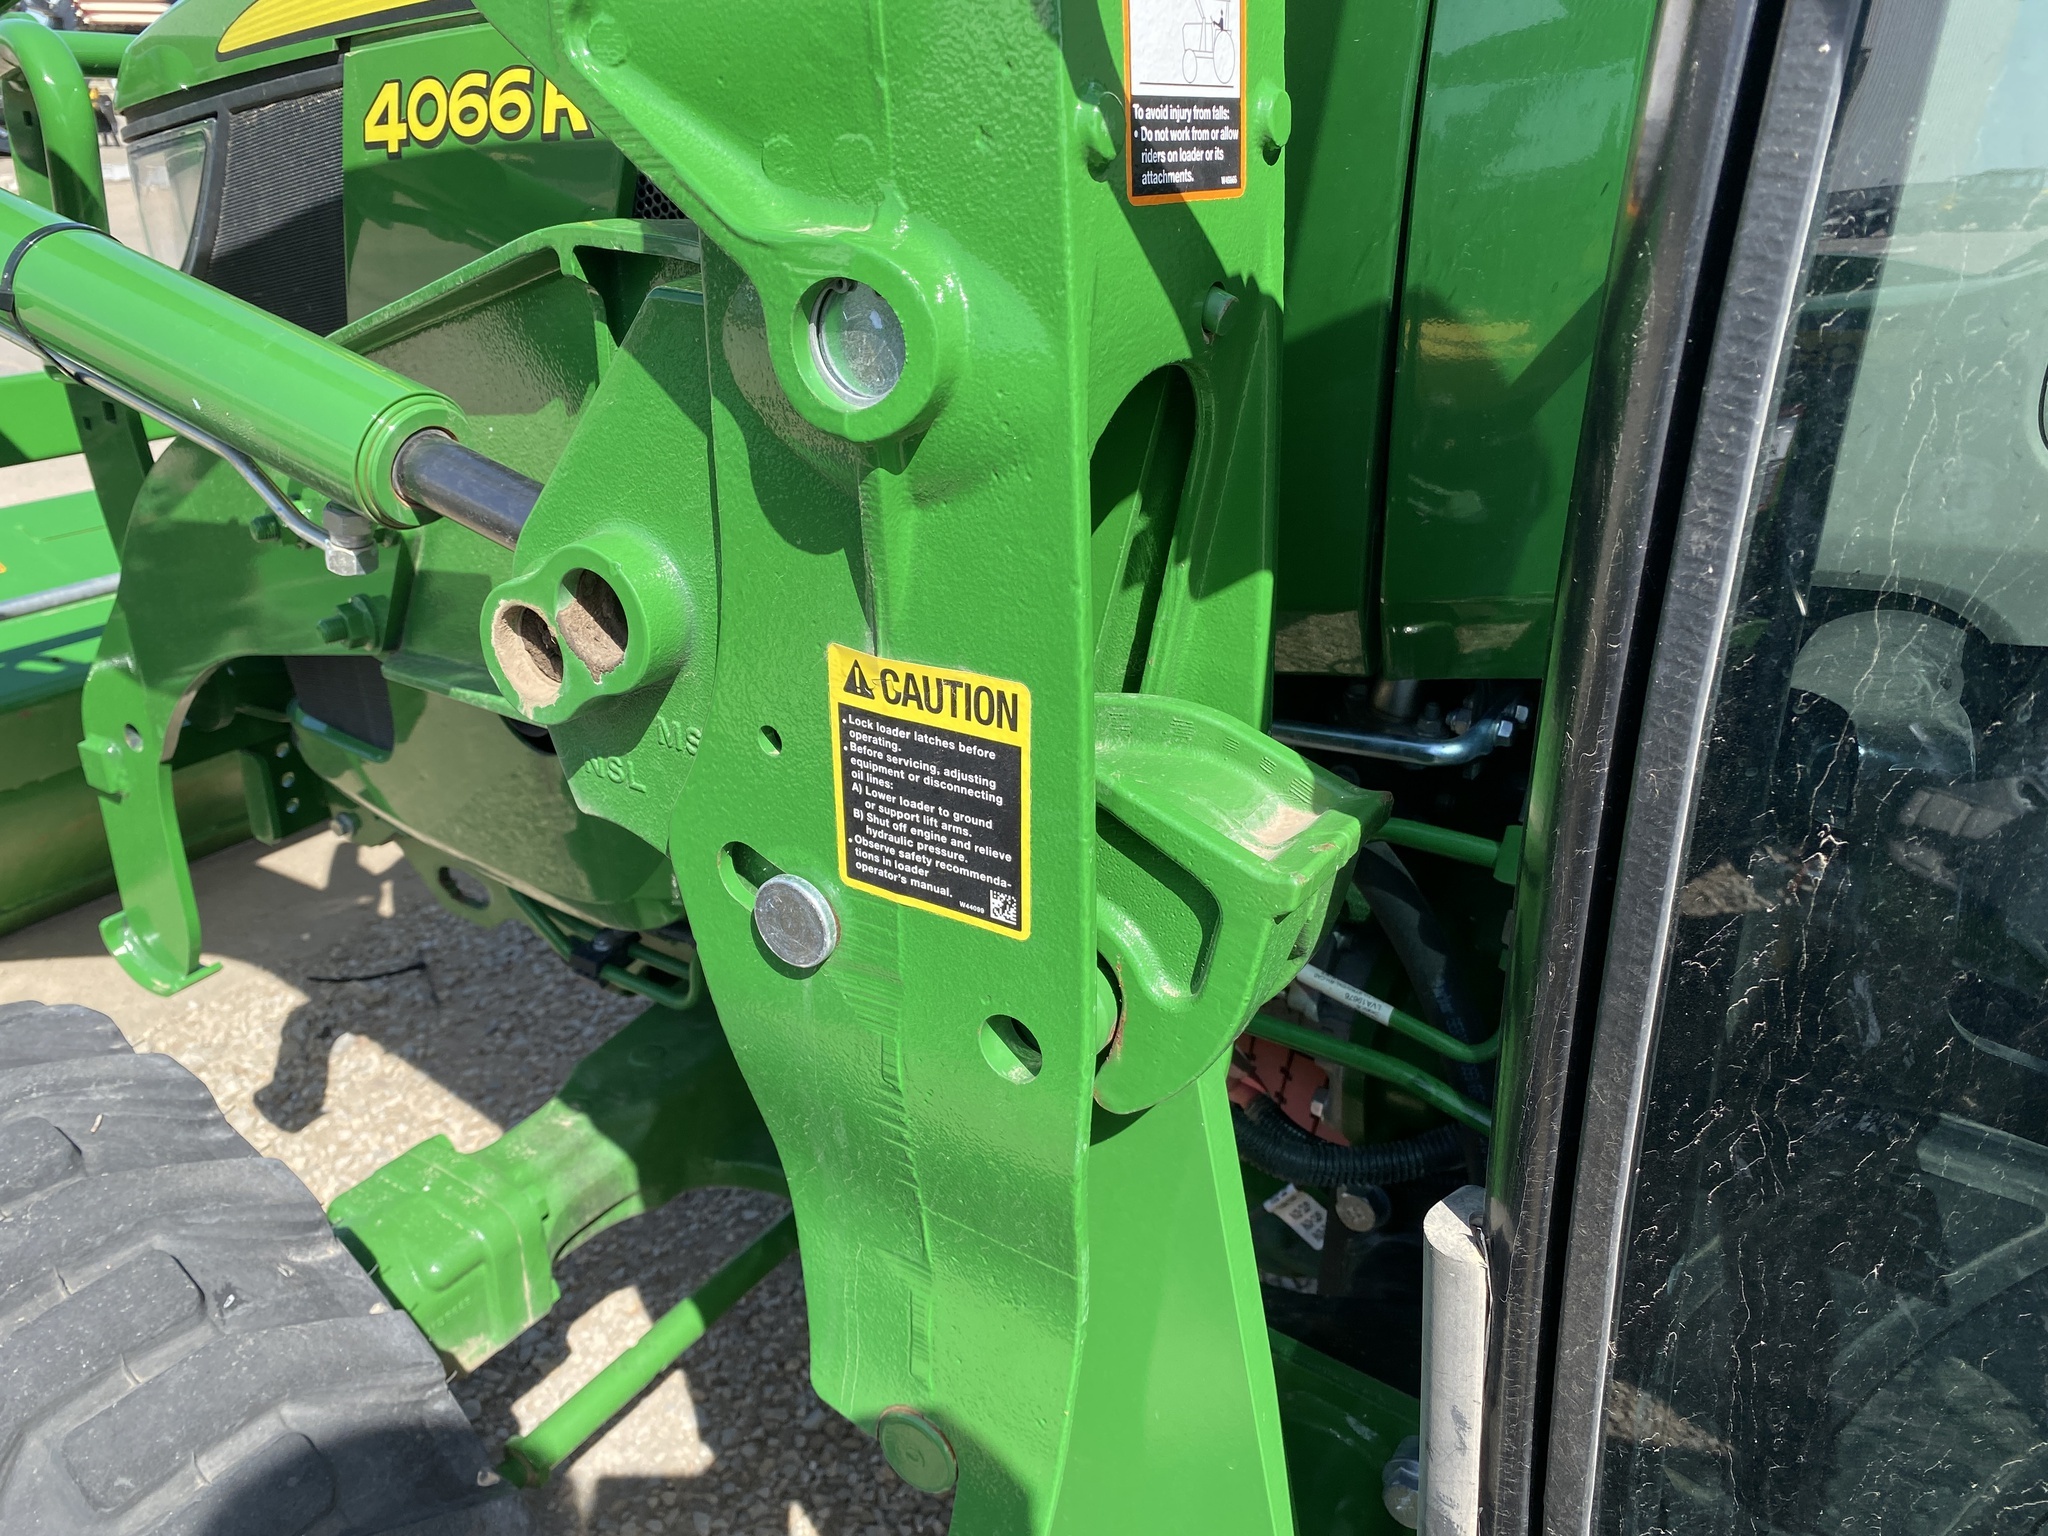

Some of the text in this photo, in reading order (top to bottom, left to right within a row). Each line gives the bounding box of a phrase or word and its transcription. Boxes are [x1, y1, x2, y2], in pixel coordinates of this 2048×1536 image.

[1132, 103, 1230, 123] To avoid injury from falls:
[1140, 126, 1239, 142] Do not work from or allow
[1141, 146, 1224, 163] riders on loader or its
[1141, 168, 1195, 185] attachments.
[880, 668, 1018, 732] CAUTION
[848, 714, 996, 760] Lock loader latches before
[849, 730, 902, 752] operating.
[850, 742, 997, 790] Before servicing, adjusting
[850, 757, 1003, 806] equipment or disconnecting
[851, 770, 894, 790] oil lines:
[852, 783, 993, 830] A) Lower loader to ground
[865, 800, 972, 837] or support lift arms.
[853, 808, 1012, 863] B) Shut off engine and relieve
[865, 825, 968, 863] hydraulic pressure.
[854, 836, 1012, 889] Observe safety recommenda-
[854, 848, 930, 878] tions in loader
[855, 862, 953, 898] operator's manual.
